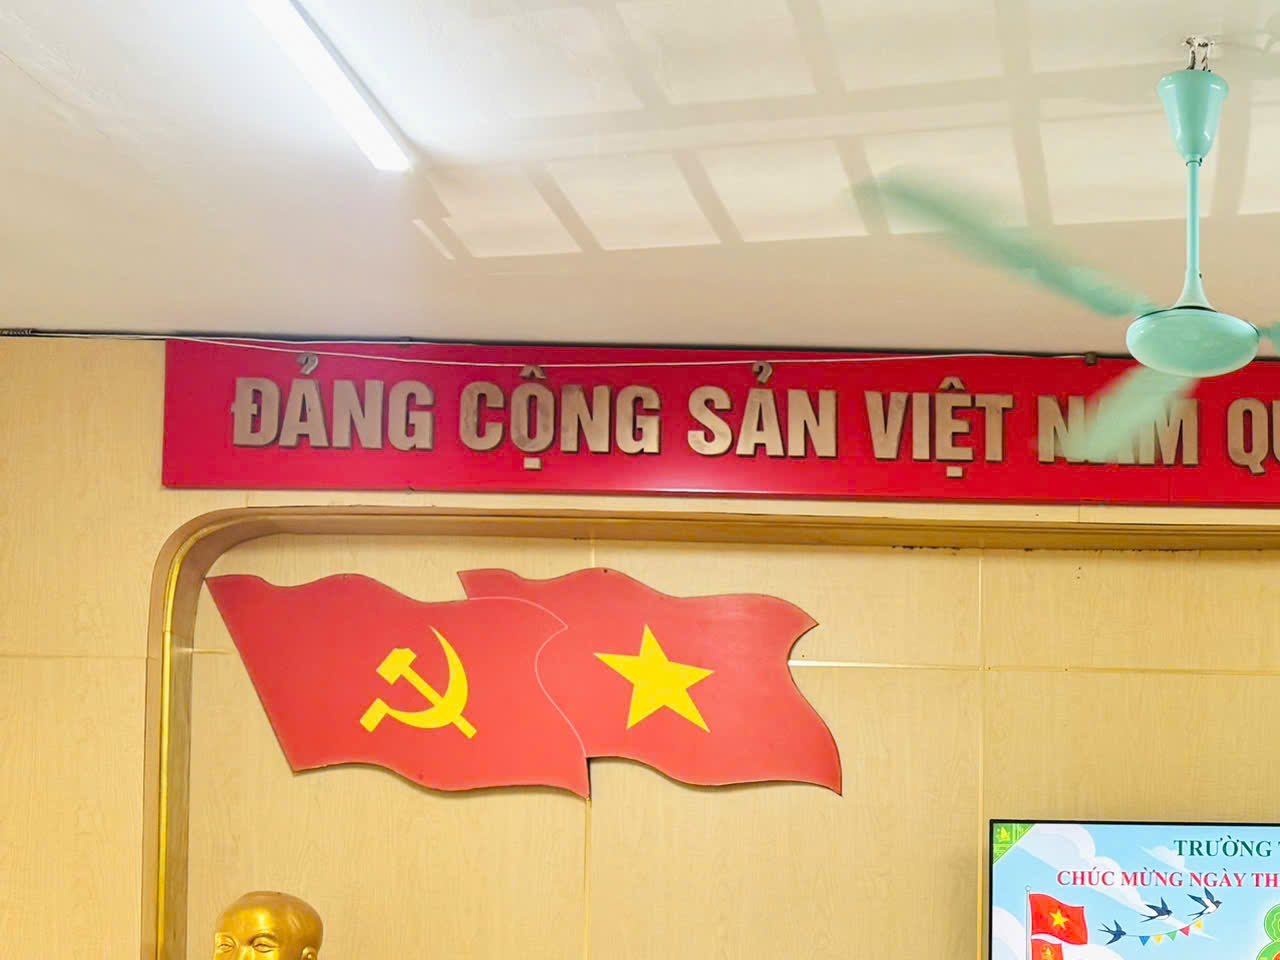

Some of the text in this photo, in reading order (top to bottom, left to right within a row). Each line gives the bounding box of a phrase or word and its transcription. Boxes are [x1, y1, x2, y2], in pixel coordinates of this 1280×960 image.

[232, 355, 433, 450] ĐẢNG
[458, 365, 660, 471] CỘNG
[687, 361, 838, 459] SẢN
[865, 377, 1012, 479] VIỆT
[1037, 395, 1198, 467] NM
[1173, 835, 1272, 858] TRƯỜNG
[1057, 866, 1114, 886] CHÚC
[1120, 867, 1183, 887] MỪNG
[1189, 868, 1246, 888] NGÀY
